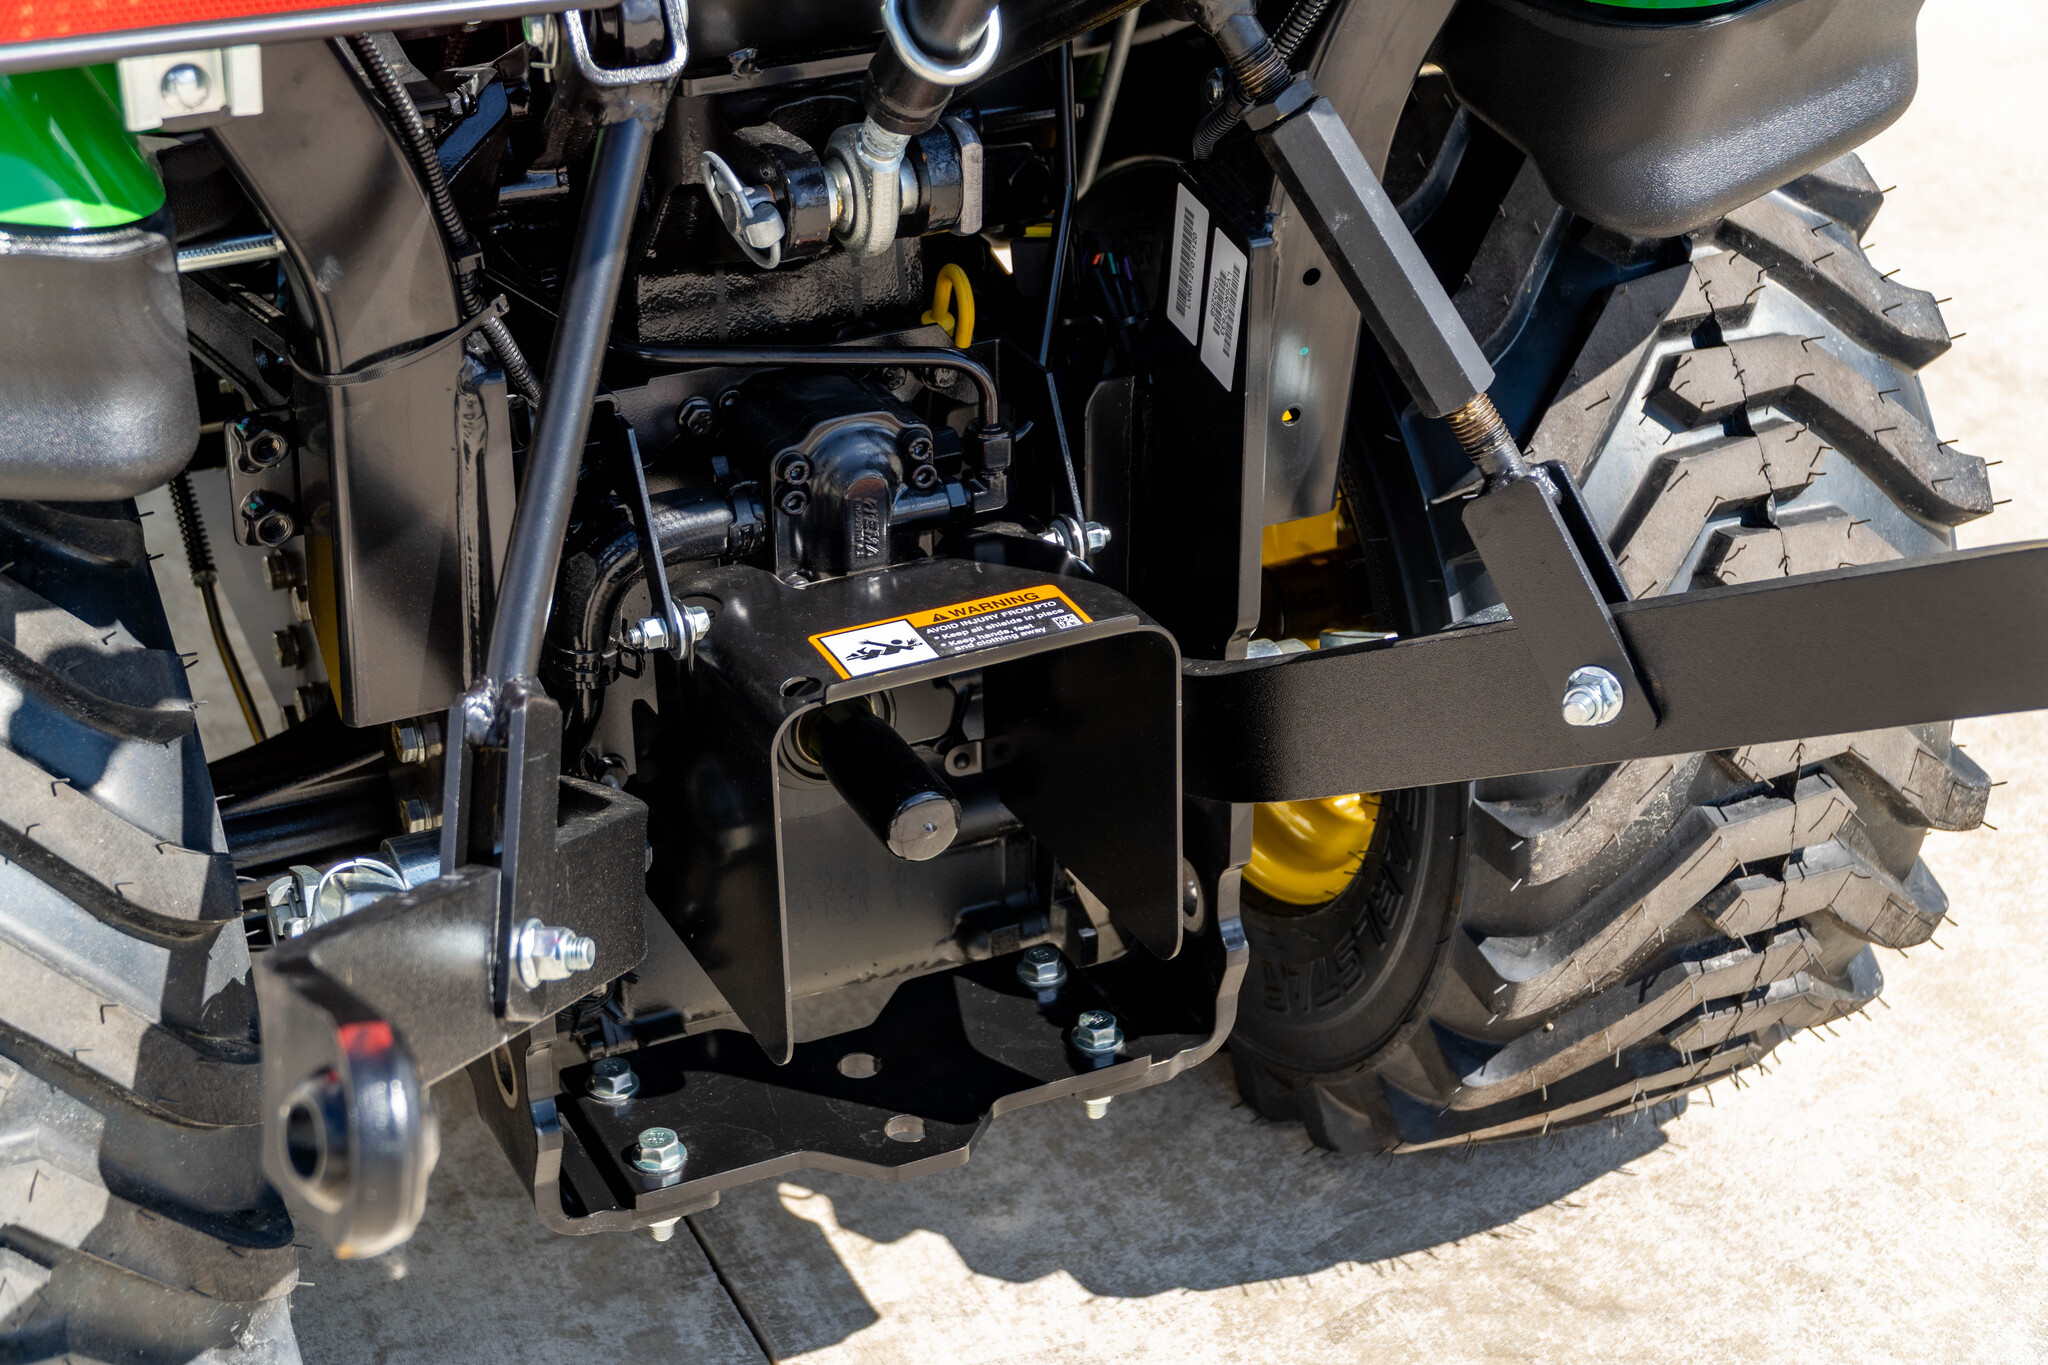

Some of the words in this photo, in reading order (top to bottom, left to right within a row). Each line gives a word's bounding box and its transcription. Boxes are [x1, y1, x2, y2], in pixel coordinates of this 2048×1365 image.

[948, 592, 1040, 617] WARNING
[926, 622, 959, 634] AVOID
[960, 613, 999, 627] INJURY
[1001, 606, 1034, 617] FROM
[1033, 601, 1057, 610] PTO
[941, 630, 970, 640] Keep
[971, 625, 985, 633] all
[985, 617, 1024, 630] shields
[1036, 608, 1065, 619] place
[948, 637, 976, 647] Keep
[976, 629, 1014, 640] hands,
[1013, 623, 1035, 632] feet
[954, 642, 976, 651] and
[976, 633, 1020, 647] clothing
[1020, 626, 1047, 638] away
